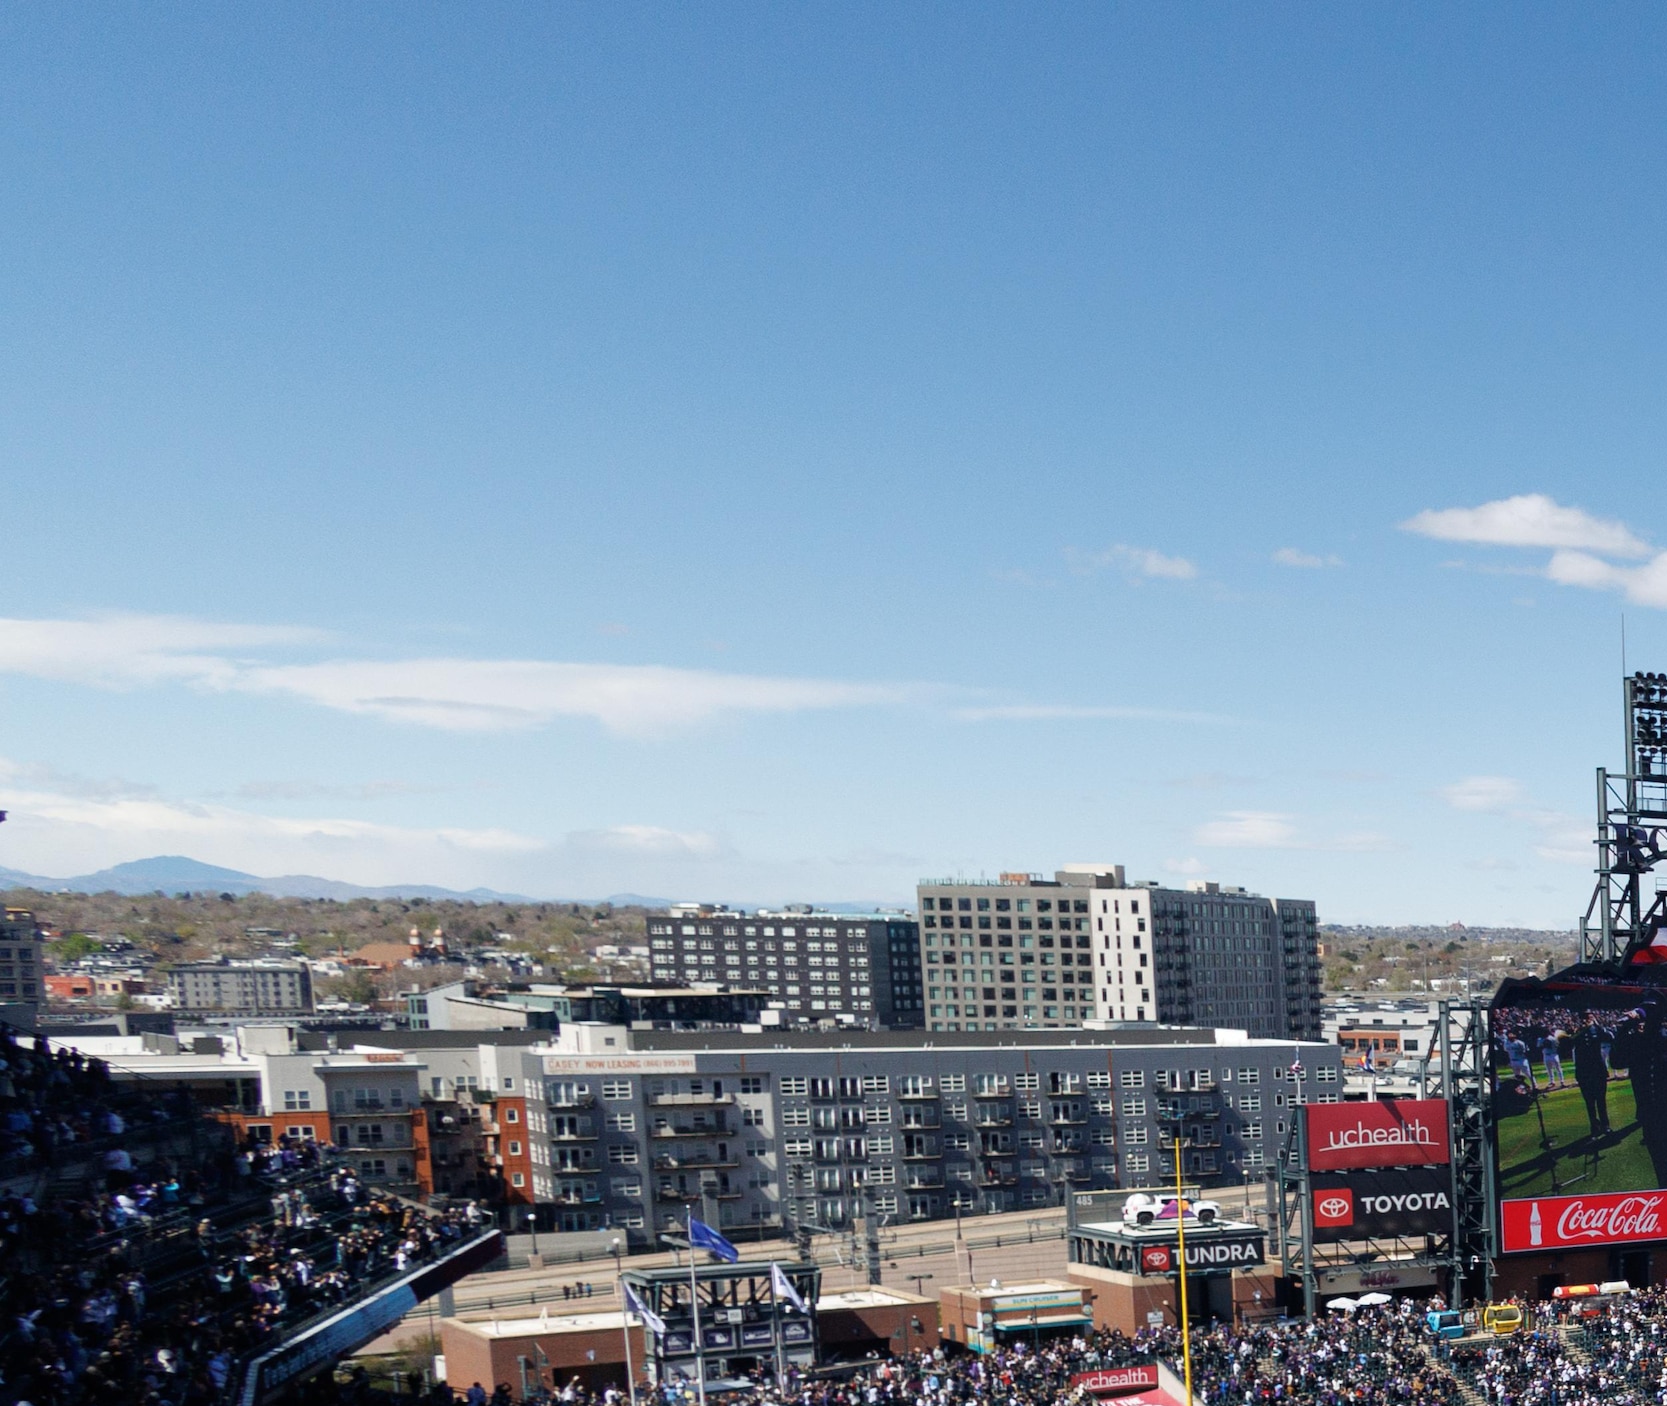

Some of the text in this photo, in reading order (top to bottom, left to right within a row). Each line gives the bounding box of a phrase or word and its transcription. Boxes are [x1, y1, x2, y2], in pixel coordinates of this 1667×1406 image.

[1330, 1120, 1429, 1148] uchealth
[1076, 1195, 1092, 1205] 485
[1361, 1192, 1450, 1214] TOYOTA
[1557, 1196, 1664, 1240] Coca-Cola
[1172, 1243, 1258, 1266] TUNDRA
